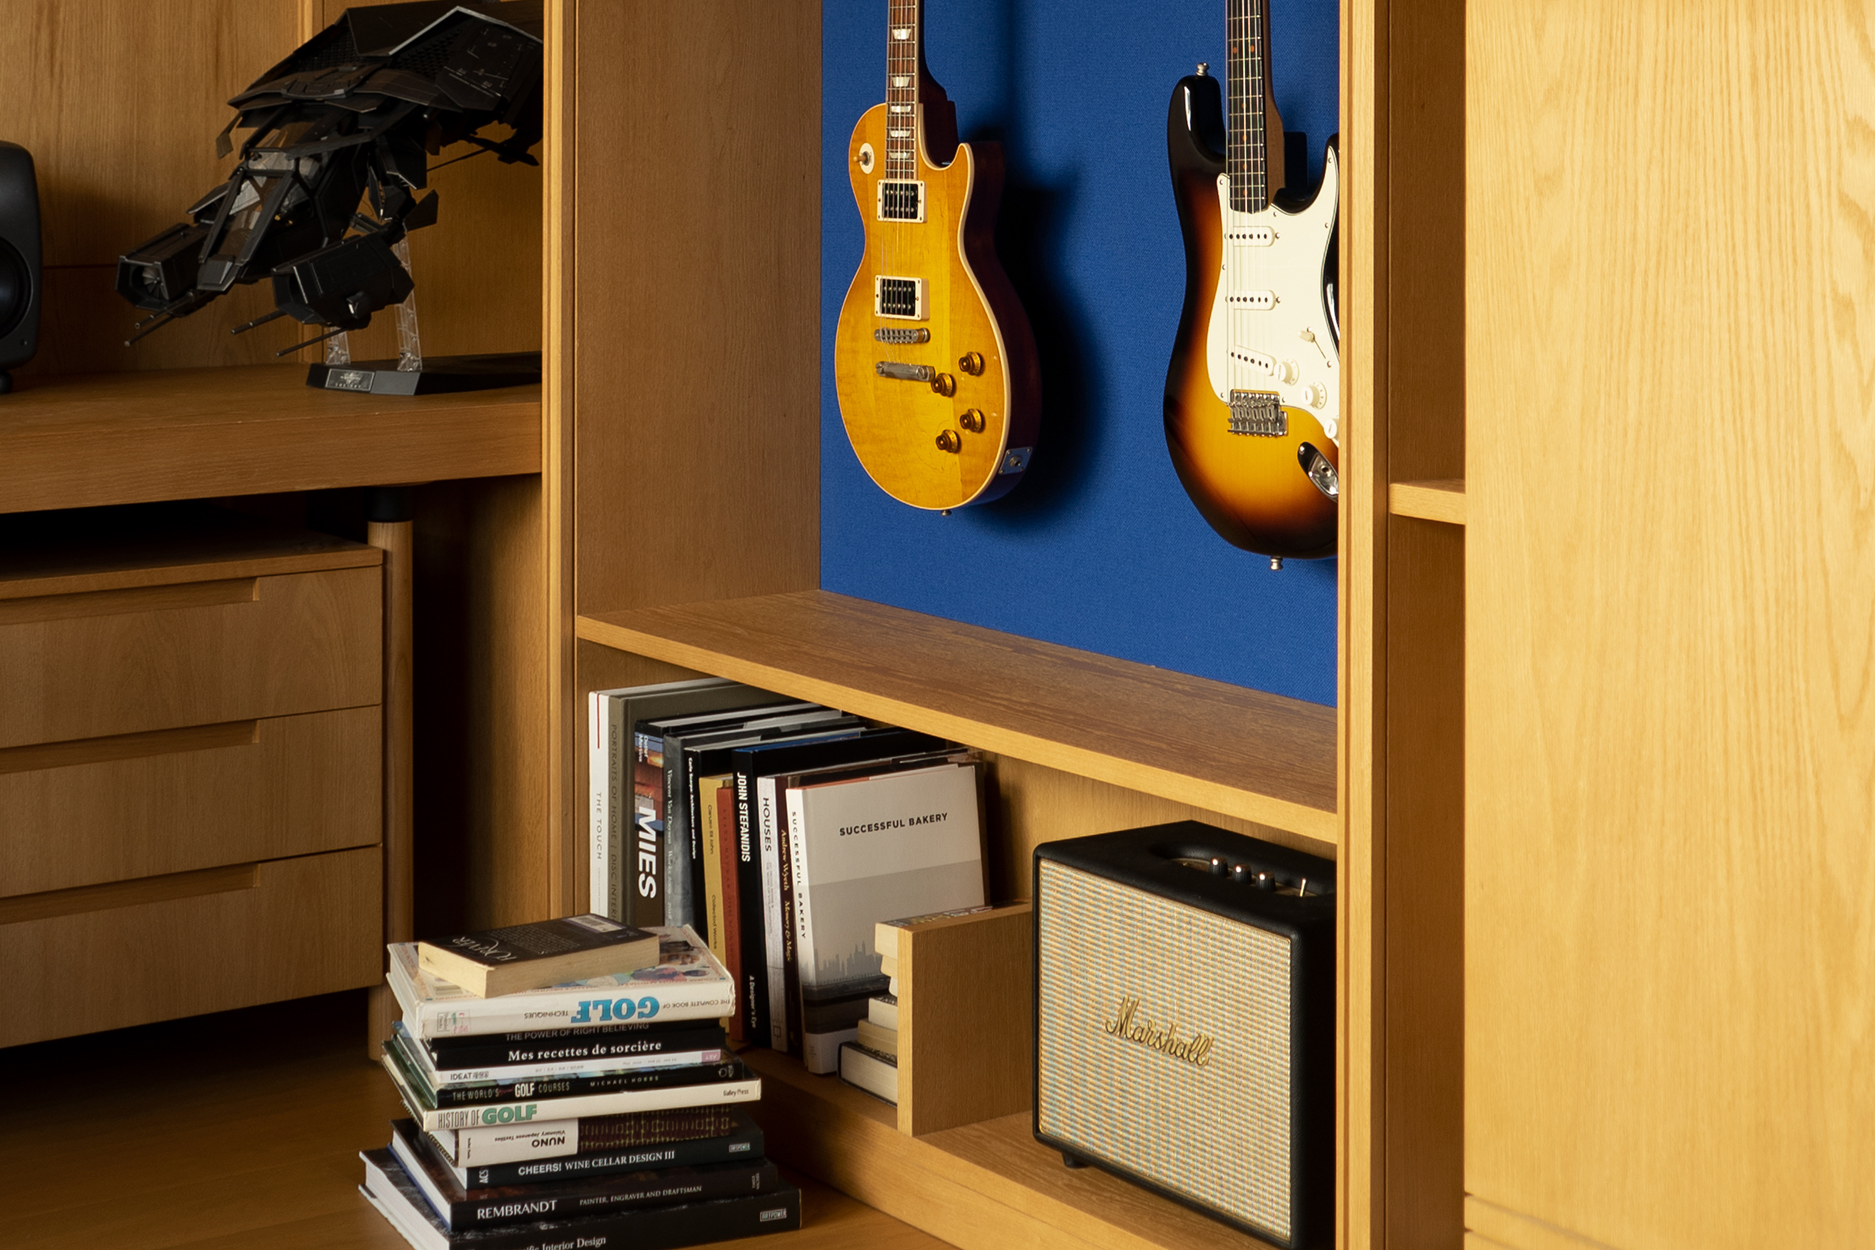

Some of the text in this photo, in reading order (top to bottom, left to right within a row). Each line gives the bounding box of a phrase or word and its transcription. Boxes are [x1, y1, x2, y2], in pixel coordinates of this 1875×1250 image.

[611, 786, 618, 800] OF
[737, 772, 750, 863] JOHN STEFANIDIS
[763, 797, 772, 852] HOUSES
[839, 812, 949, 836] SUCCESSFUL BAKERY
[638, 806, 657, 899] MIES
[792, 811, 806, 939] SUCCESSFUL BAKERY
[524, 1010, 569, 1020] TECHNIQUES
[571, 996, 660, 1023] GOLF
[691, 999, 720, 1008] COMPLETE
[506, 1022, 650, 1043] THE POWER OF RIGHT BELIEVING
[1105, 996, 1211, 1067] Marshall
[508, 1040, 662, 1062] Mes recettes de sorcière
[450, 1072, 472, 1081] IDEAT
[452, 1090, 466, 1101] THE
[467, 1088, 500, 1099] WORLD'S
[514, 1082, 536, 1098] GOLF
[538, 1081, 570, 1094] COURSES
[590, 1076, 627, 1087] MICHAEL
[437, 1087, 750, 1129] HISTORY OF GOLF Press
[515, 1132, 538, 1140] Japanese
[531, 1136, 566, 1148] NUNO
[537, 1129, 566, 1138] Visionary
[479, 1149, 675, 1184] ACS CHEERS! WINE CELLAR DESIGN III
[477, 1200, 558, 1220] REMBRANDT
[610, 1190, 645, 1203] ENGRAVER
[646, 1189, 661, 1199] AND
[662, 1185, 702, 1197] DRAFTSMAN
[542, 1236, 606, 1250] Interior Design
